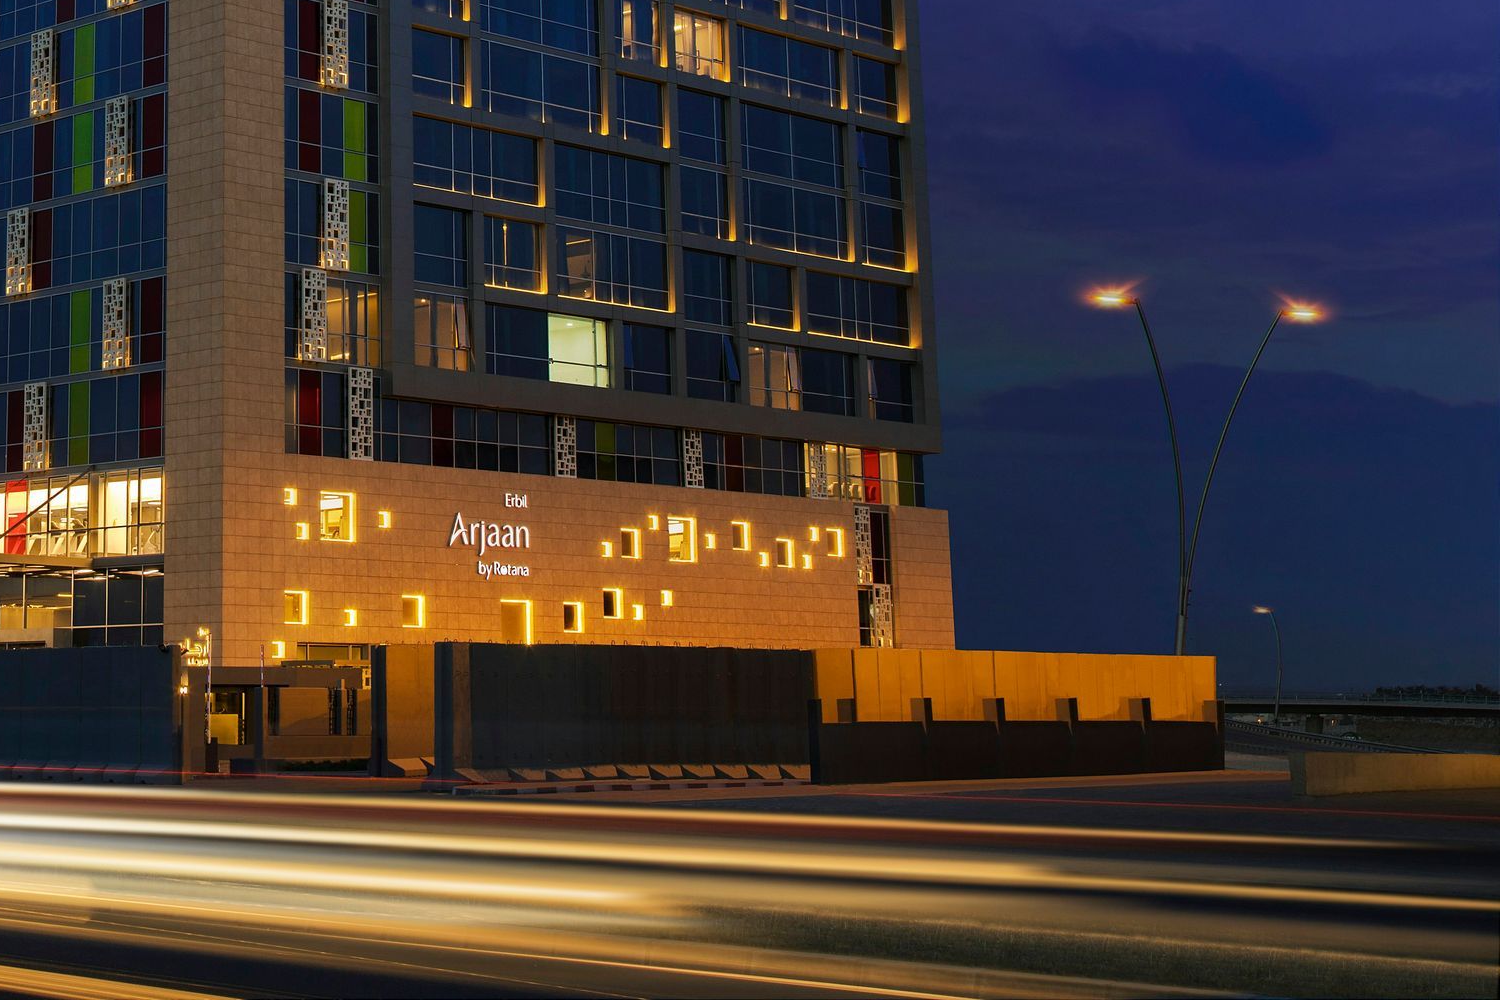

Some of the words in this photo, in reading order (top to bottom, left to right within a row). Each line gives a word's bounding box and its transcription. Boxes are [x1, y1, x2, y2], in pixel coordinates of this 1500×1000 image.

[504, 493, 528, 509] Erbil
[449, 511, 530, 556] Arjaan
[477, 560, 493, 580] by
[493, 561, 530, 577] Rotana
